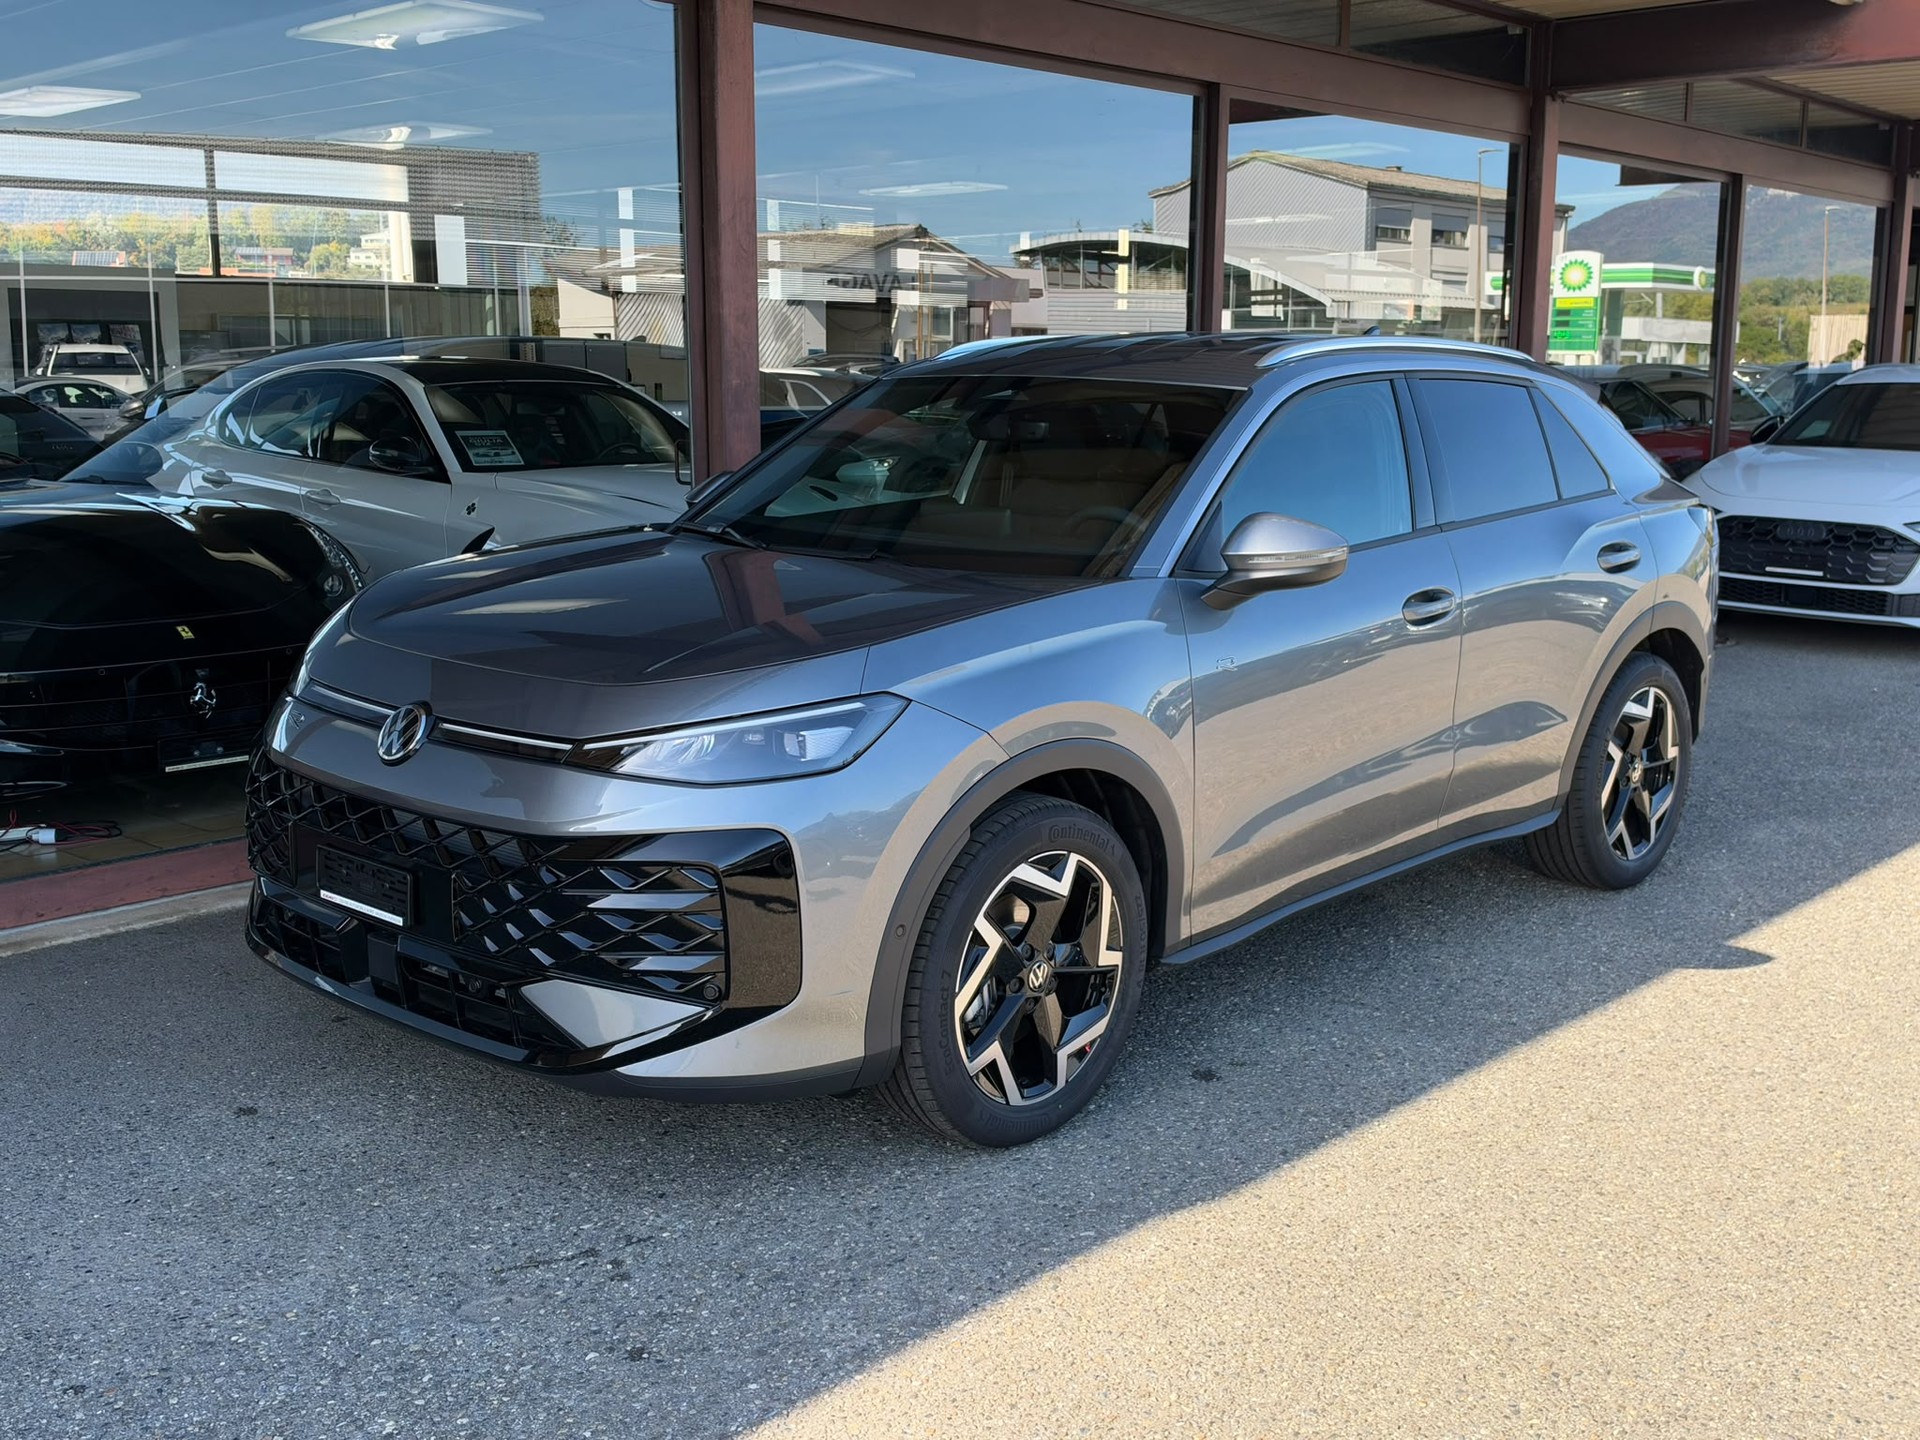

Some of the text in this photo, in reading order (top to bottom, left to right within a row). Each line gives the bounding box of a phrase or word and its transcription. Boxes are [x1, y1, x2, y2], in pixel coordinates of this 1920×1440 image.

[1048, 824, 1109, 851] Continental
[938, 969, 954, 1076] EcoContact 7
